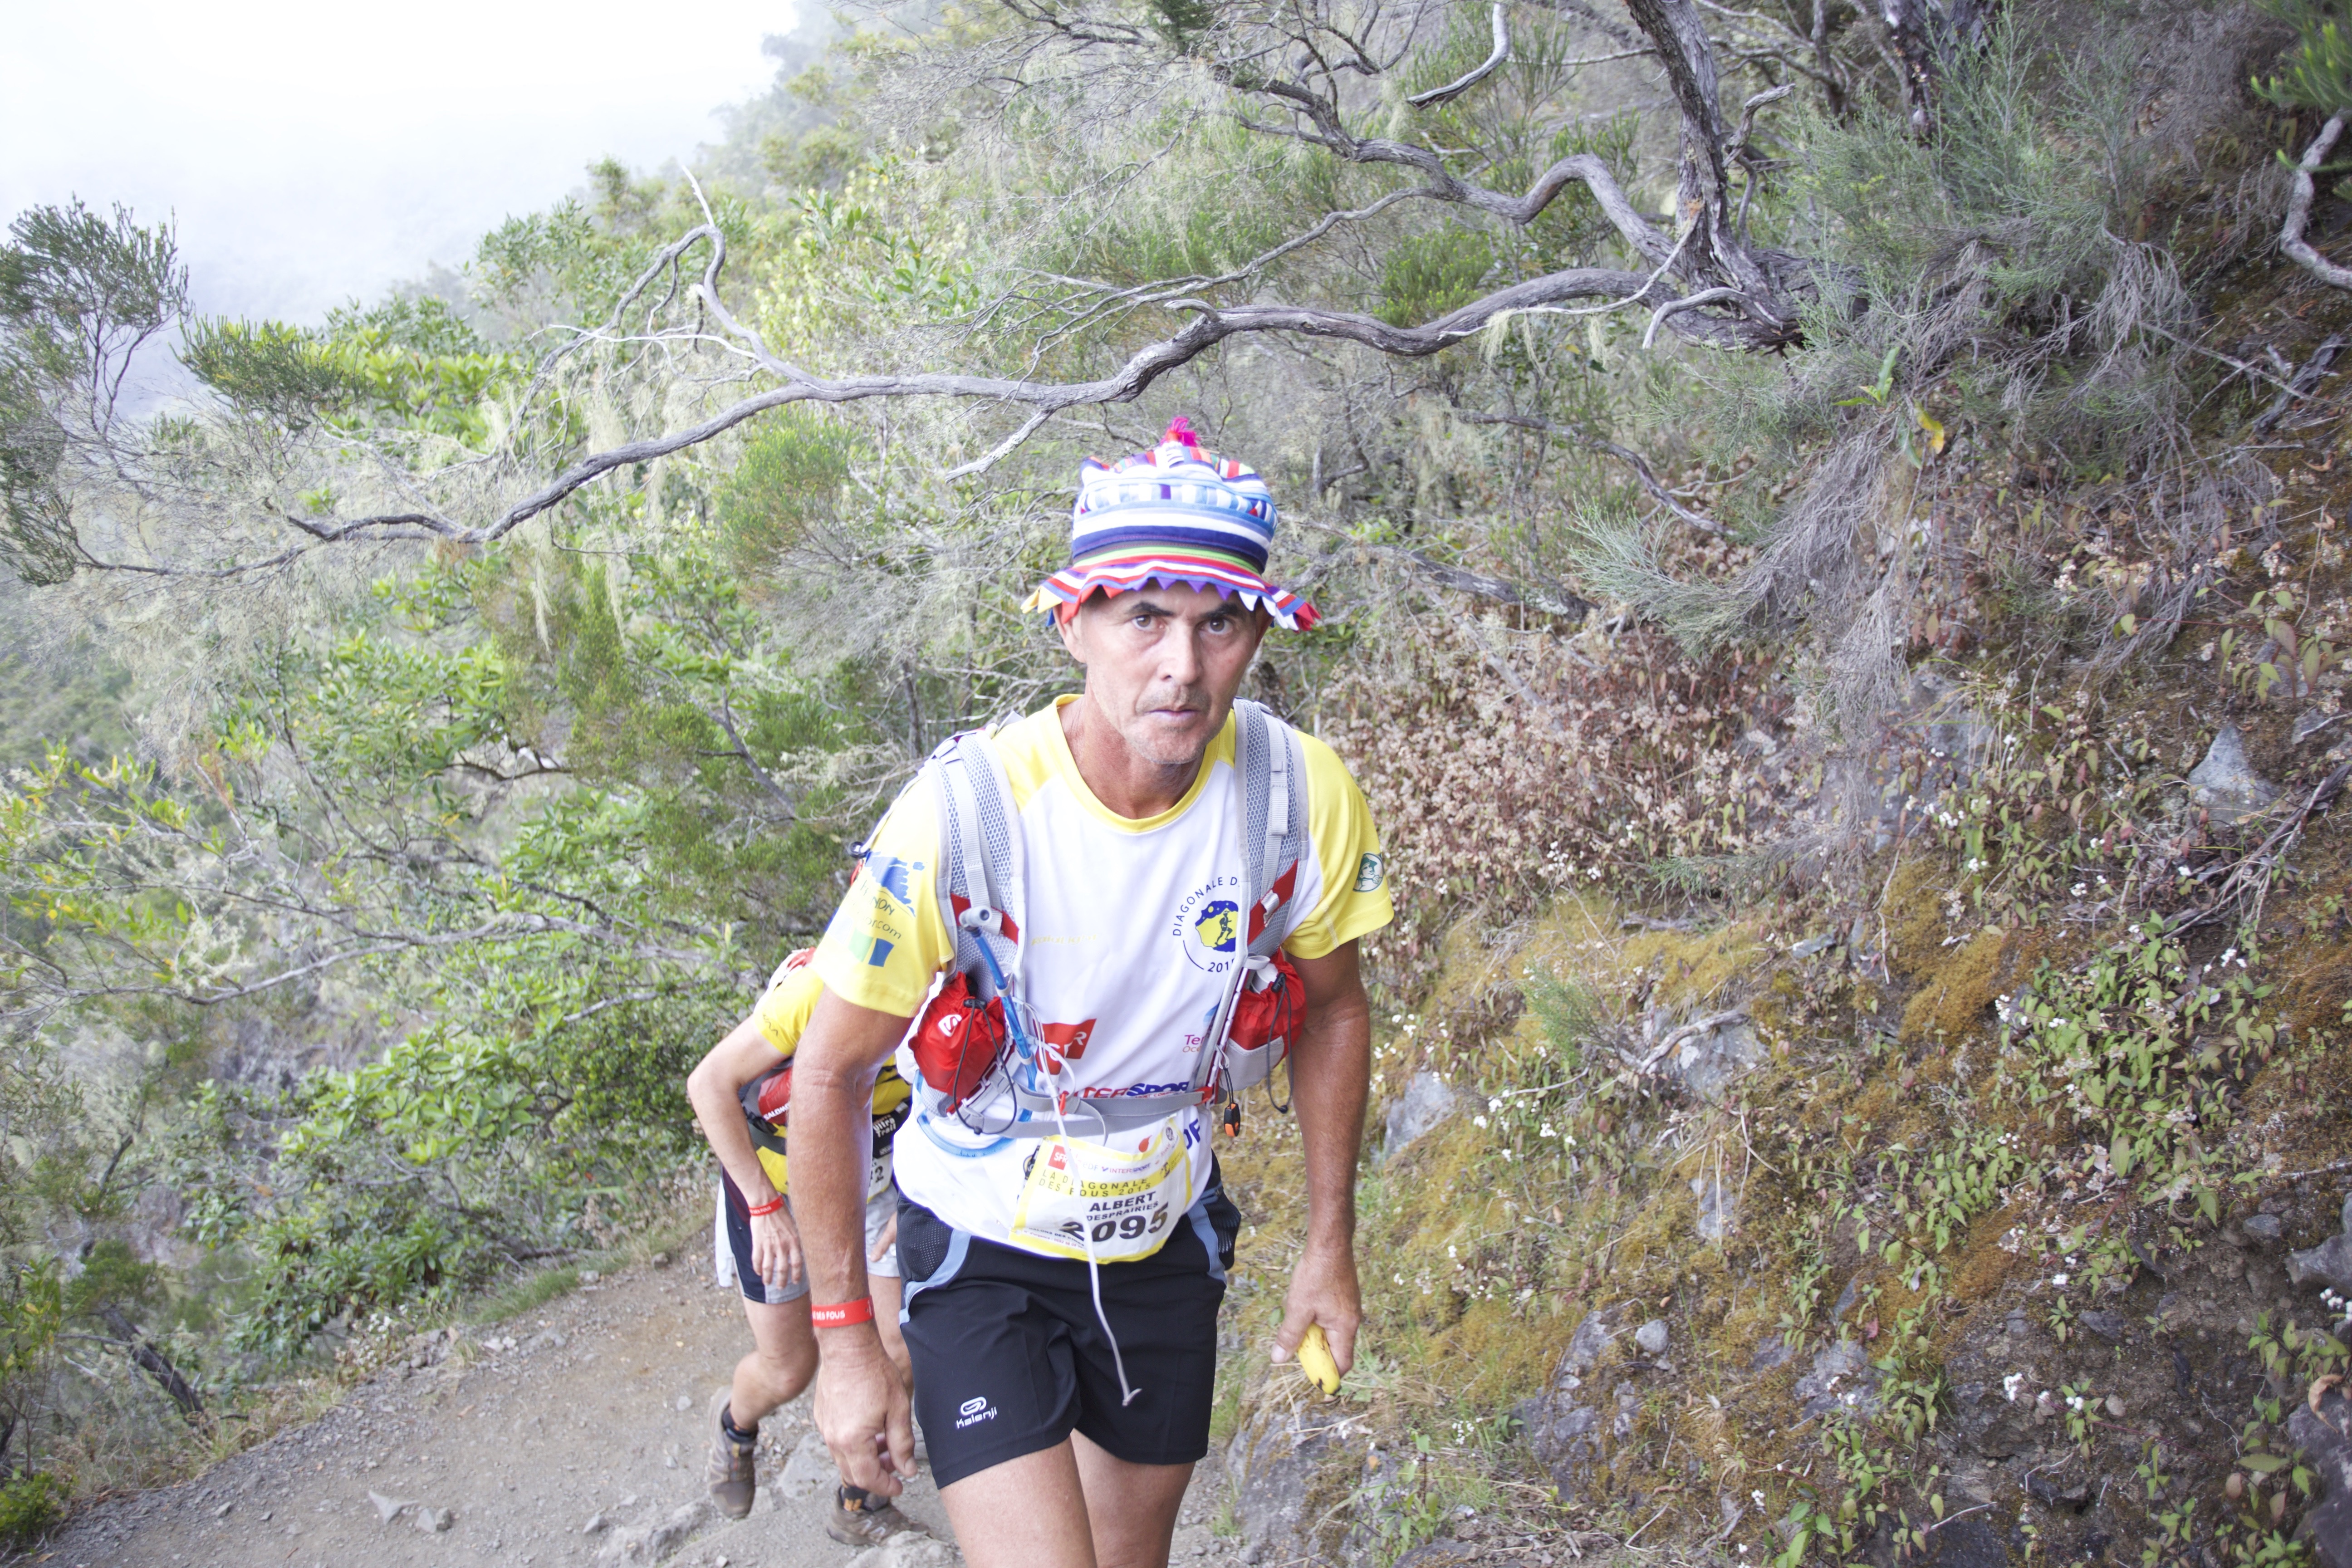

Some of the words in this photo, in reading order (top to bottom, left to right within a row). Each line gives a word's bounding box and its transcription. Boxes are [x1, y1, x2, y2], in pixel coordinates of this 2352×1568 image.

[1173, 877, 1224, 936] DIAGONALE
[1230, 877, 1240, 887] D
[1042, 1169, 1056, 1180] LA
[1109, 1162, 1151, 1174] INTERSPORT
[1039, 1178, 1061, 1191] DES
[1069, 1187, 1108, 1197] FOUS
[1118, 1183, 1151, 1196] 2015
[1087, 1201, 1159, 1221] DESPRAIRIES
[1089, 1191, 1156, 1212] ALBERT
[1059, 1201, 1169, 1242] 2095
[826, 1310, 846, 1320] FOUS
[956, 1406, 997, 1429] Kalenji
